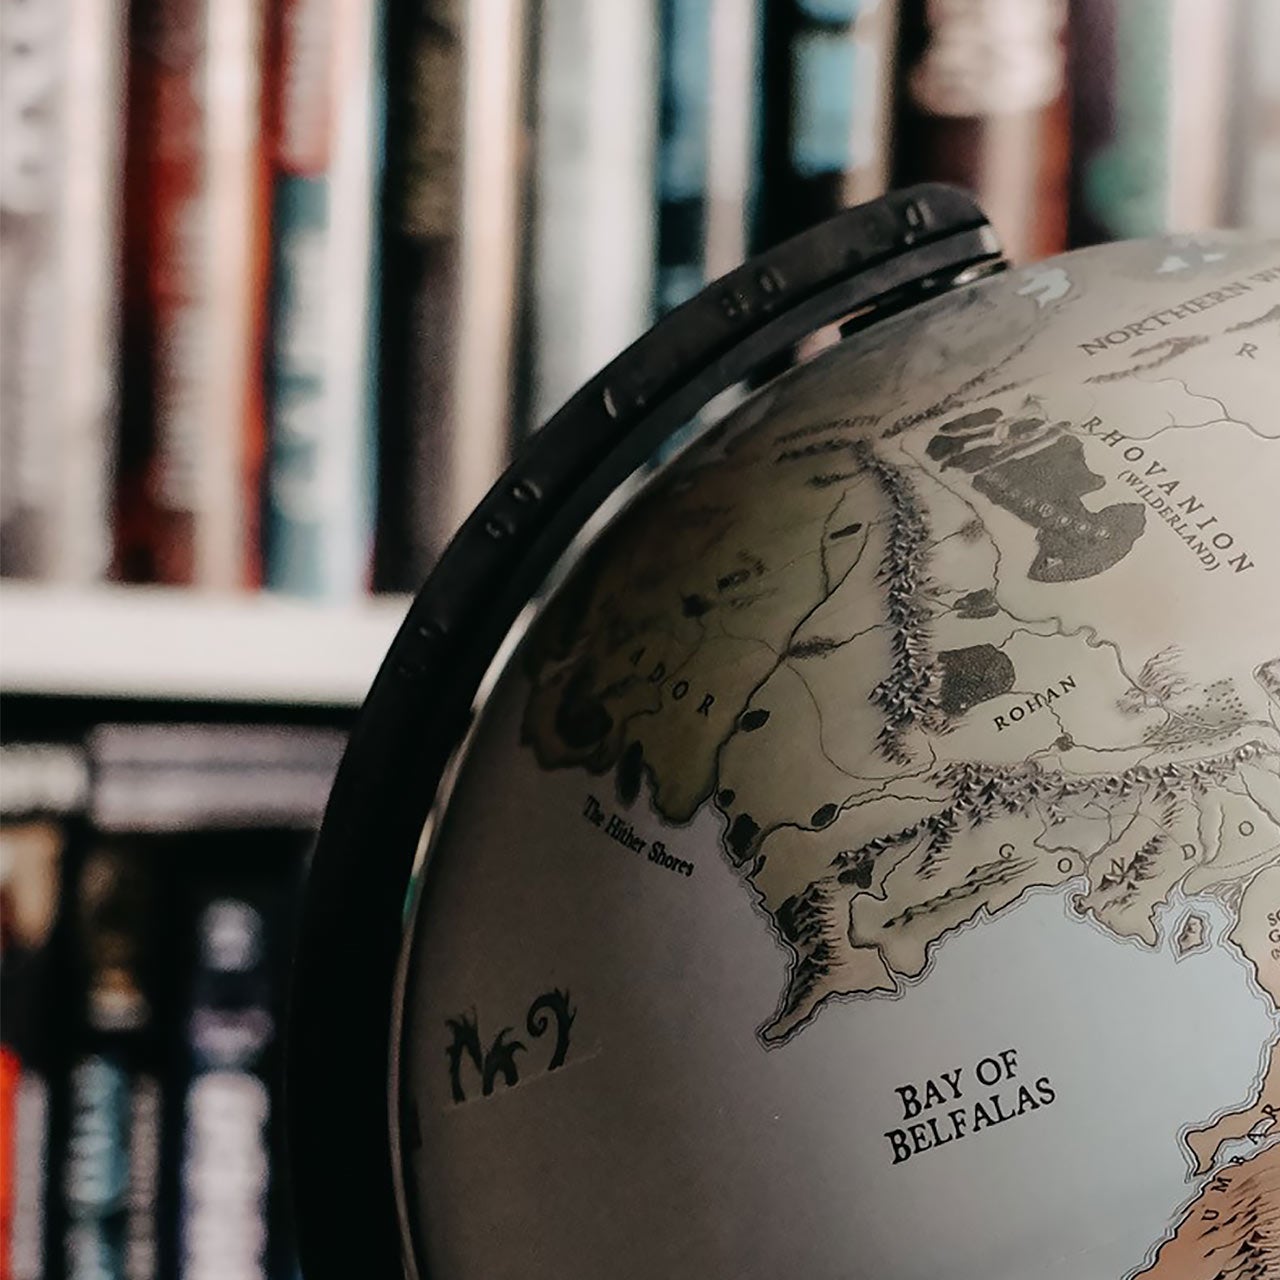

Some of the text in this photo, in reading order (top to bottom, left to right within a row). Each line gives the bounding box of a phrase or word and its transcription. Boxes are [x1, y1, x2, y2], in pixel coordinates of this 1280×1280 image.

[1078, 282, 1252, 356] NORTHERN
[1081, 416, 1254, 573] RHOVANION
[1117, 470, 1220, 571] (WILDERLAND)
[993, 675, 1076, 731] ROHAN
[583, 794, 695, 877] The Hither Shores
[884, 1076, 1056, 1165] BELFALAS
[894, 1048, 1018, 1121] BAY OF
